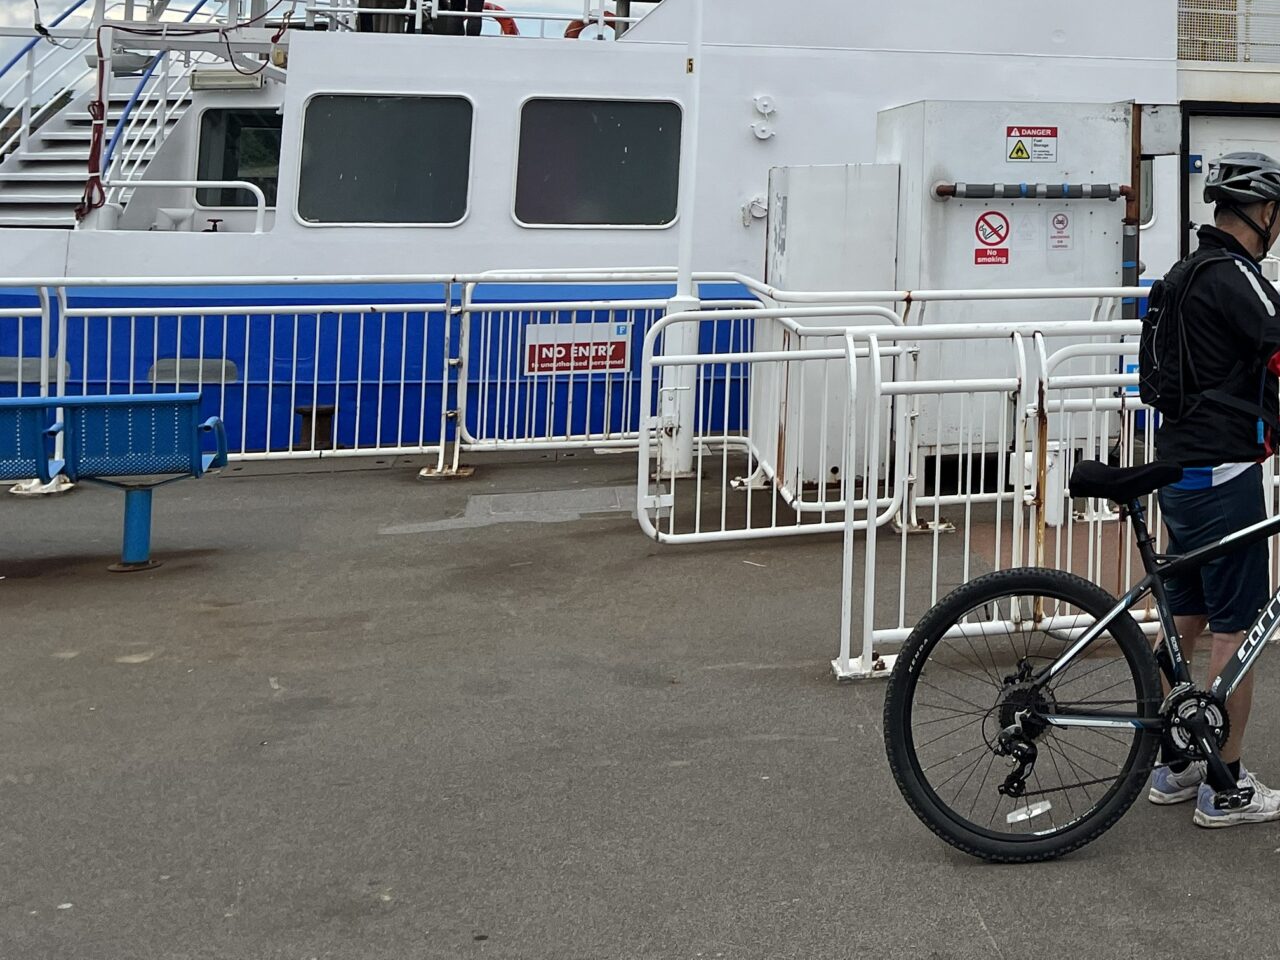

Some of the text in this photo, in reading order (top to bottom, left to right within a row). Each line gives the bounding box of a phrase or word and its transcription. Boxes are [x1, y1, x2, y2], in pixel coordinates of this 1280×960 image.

[977, 256, 1007, 264] smoking
[542, 344, 616, 359] NO ENTRY
[908, 638, 928, 673] KENDA
